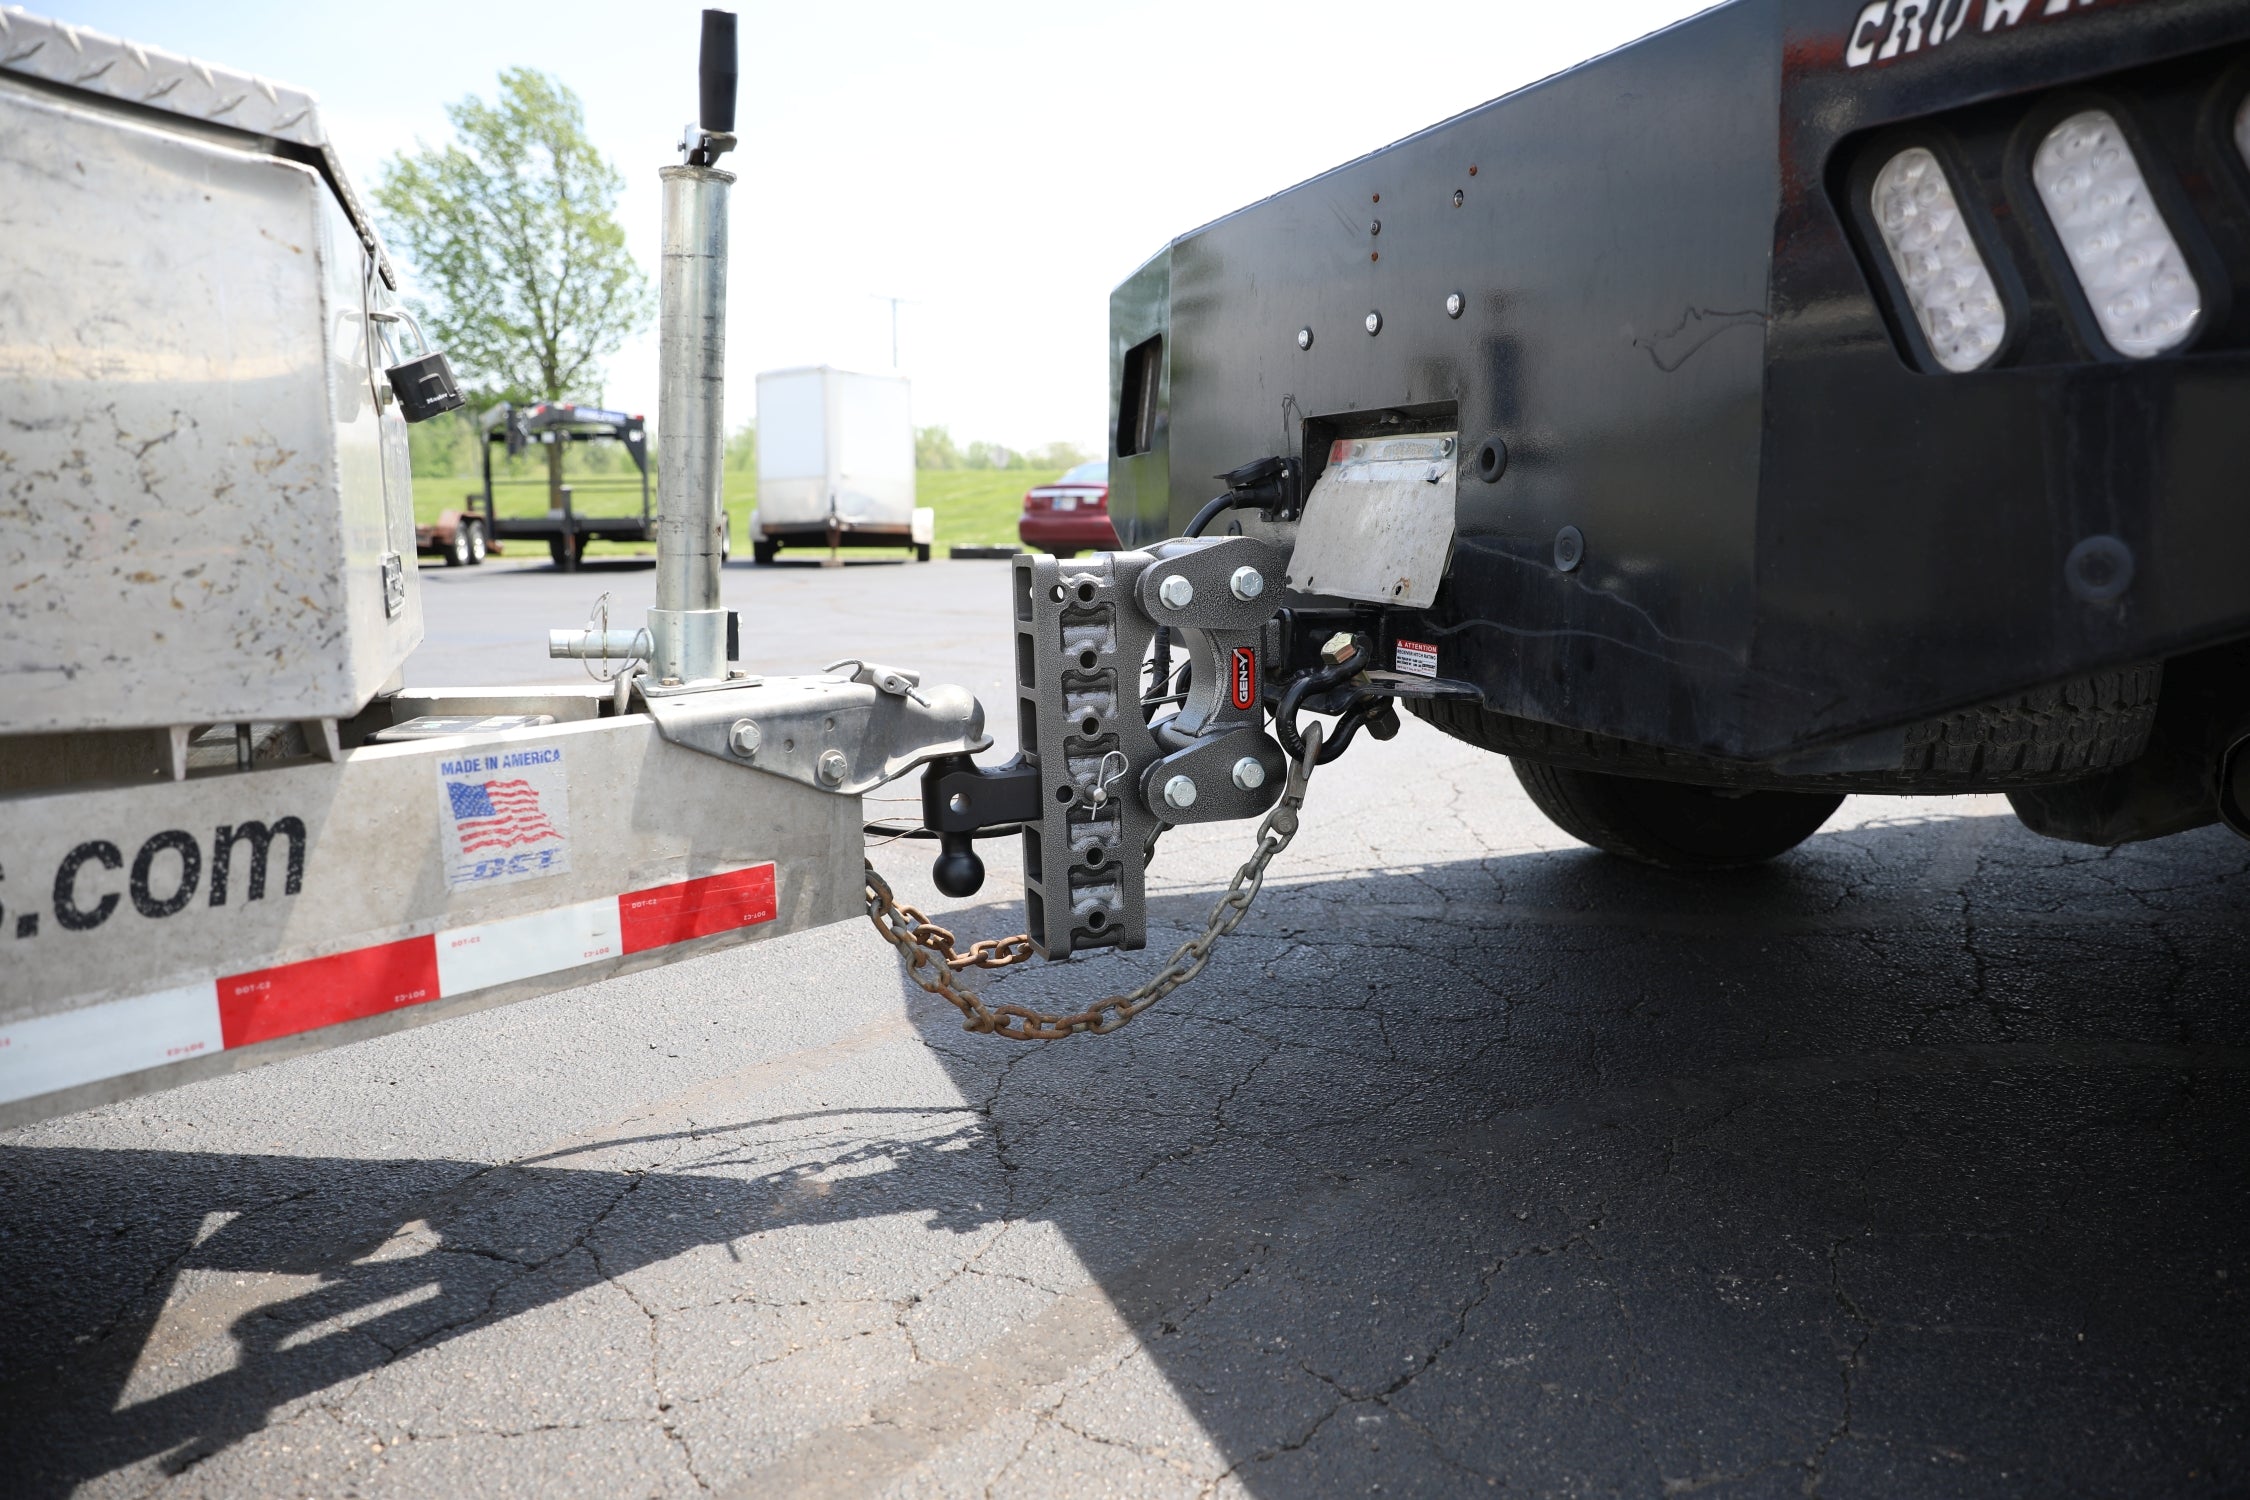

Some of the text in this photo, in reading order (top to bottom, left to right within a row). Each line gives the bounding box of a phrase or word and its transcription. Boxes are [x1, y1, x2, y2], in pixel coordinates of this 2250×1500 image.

[1404, 641, 1437, 653] ATTENTION
[1233, 648, 1248, 702] GEN-Y
[441, 748, 561, 775] MADE IN AMERICA
[0, 815, 307, 939] .com
[743, 910, 766, 921] DOT-C2
